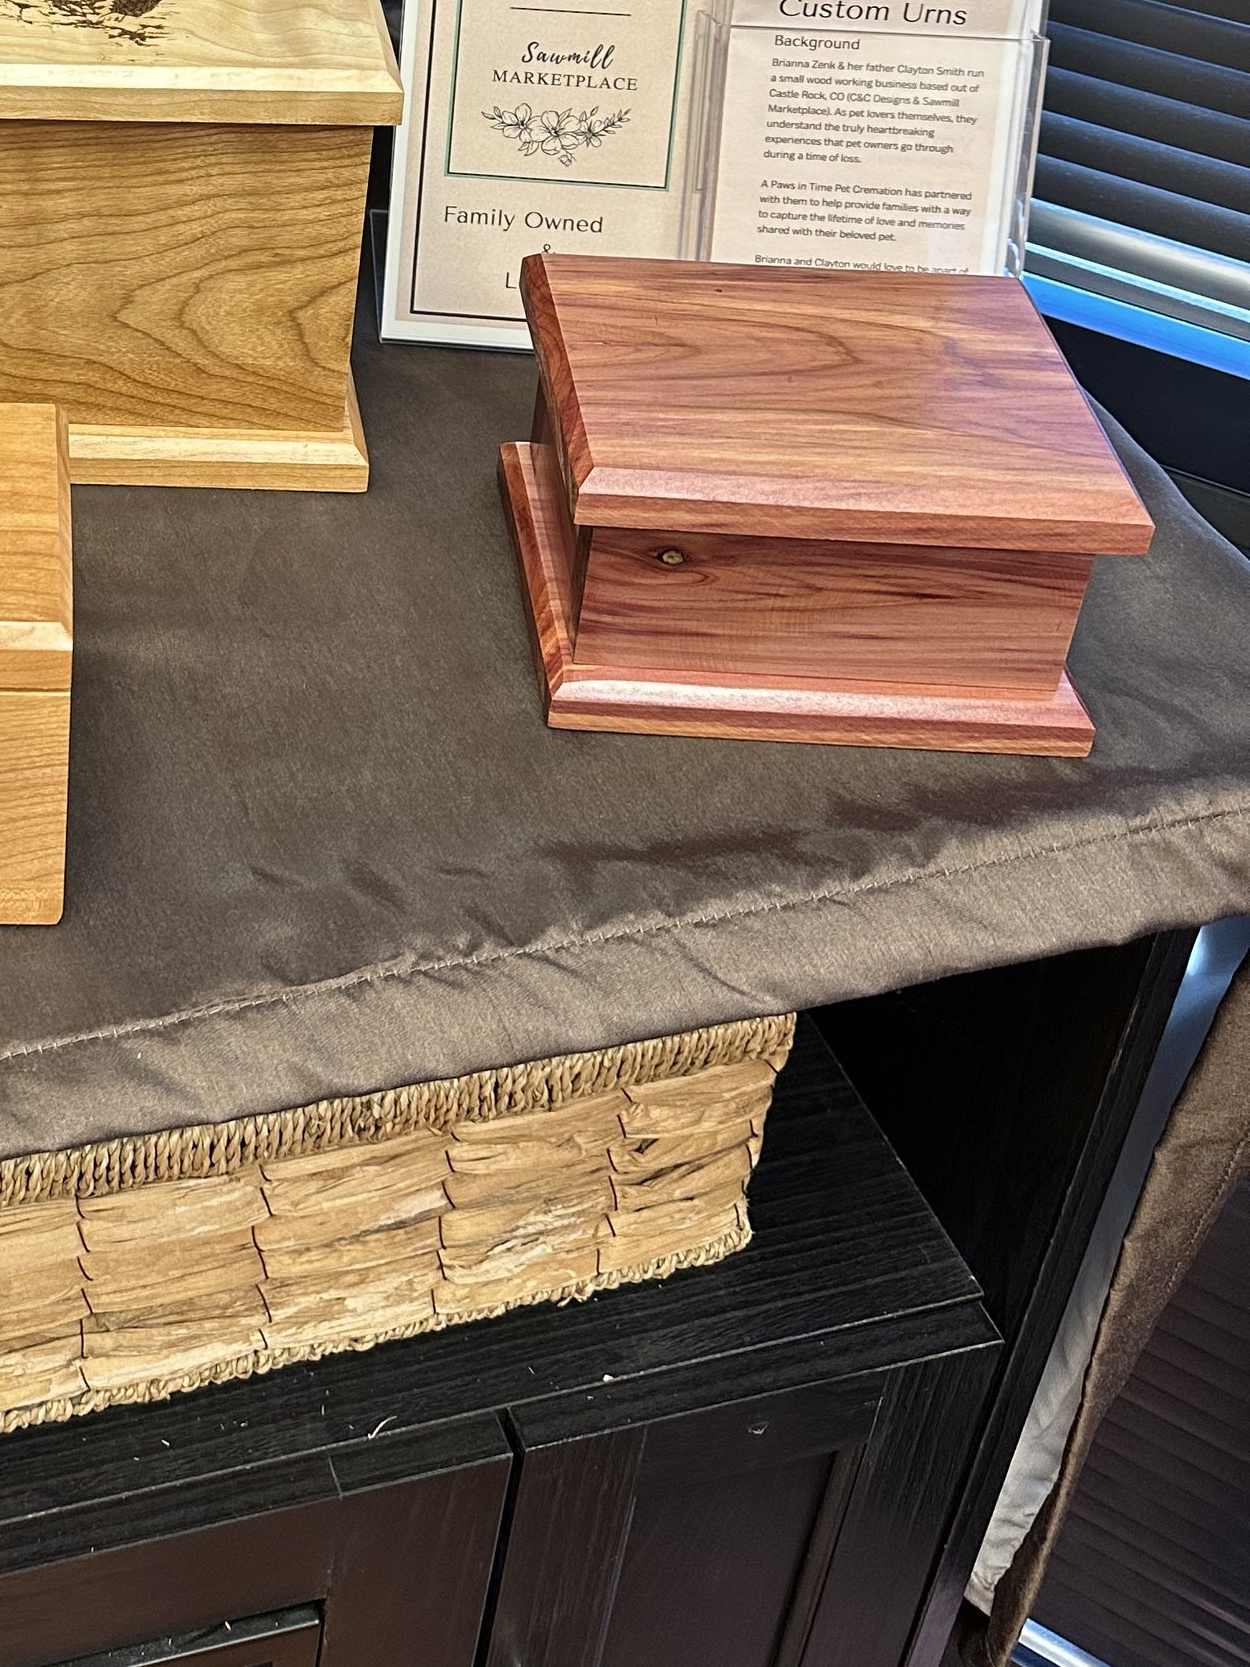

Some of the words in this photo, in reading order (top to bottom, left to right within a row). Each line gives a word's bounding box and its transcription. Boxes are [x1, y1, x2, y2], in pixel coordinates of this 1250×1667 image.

[902, 2, 968, 25] Urns
[775, 34, 860, 51] Background
[521, 41, 615, 70] Sawmill
[772, 58, 809, 68] Brianna
[812, 60, 836, 69] Zenk
[837, 62, 845, 70] &
[847, 62, 863, 71] her
[866, 63, 895, 72] father
[897, 65, 934, 75] Clayton
[937, 67, 965, 76] Smith
[492, 69, 638, 91] MARKETPLACE
[779, 75, 804, 83] small
[806, 77, 832, 85] wood
[835, 78, 873, 88] working
[875, 79, 917, 90] business
[919, 81, 948, 91] based
[951, 84, 967, 92] out
[969, 84, 980, 92] of
[769, 88, 799, 99] Castle
[830, 92, 845, 101] CO
[873, 94, 910, 106] Designs
[913, 96, 919, 105] &
[922, 96, 960, 107] Sawmill
[834, 108, 846, 116] As
[849, 109, 865, 118] pet
[866, 110, 895, 119] lovers
[956, 115, 978, 125] they
[766, 120, 822, 130] understand
[824, 123, 840, 131] the
[842, 124, 864, 134] truly
[867, 125, 935, 138] heartbreaking
[765, 135, 822, 146] experiences
[824, 138, 843, 147] that
[846, 139, 862, 148] pet
[863, 140, 898, 150] owners
[900, 143, 913, 152] go
[915, 143, 954, 154] through
[763, 150, 795, 161] during
[806, 152, 827, 161] time
[829, 153, 839, 162] of
[761, 180, 768, 188] A
[771, 180, 796, 190] Paws
[798, 182, 807, 190] in
[809, 182, 833, 192] Time
[835, 184, 851, 193] Pet
[852, 185, 902, 196] Cremation
[905, 188, 922, 197] has
[924, 190, 972, 200] partnered
[760, 195, 780, 204] with
[782, 196, 807, 205] them
[810, 198, 820, 206] to
[822, 198, 842, 209] help
[844, 201, 880, 210] provide
[882, 202, 919, 212] families
[921, 205, 942, 214] with
[952, 208, 972, 217] way
[444, 205, 516, 231] Family
[524, 211, 604, 233] Owned
[758, 210, 768, 218] to
[770, 211, 808, 221] capture
[810, 213, 826, 222] the
[828, 214, 863, 224] lifetime
[864, 216, 875, 224] of
[877, 217, 895, 226] love
[897, 219, 916, 227] and
[918, 220, 966, 230] memories
[757, 225, 790, 234] shared
[792, 227, 813, 236] with
[815, 228, 838, 237] their
[839, 230, 876, 240] beloved
[755, 254, 792, 265] Brianna
[794, 258, 812, 266] and
[814, 258, 850, 268] Clayton
[853, 261, 882, 270] would
